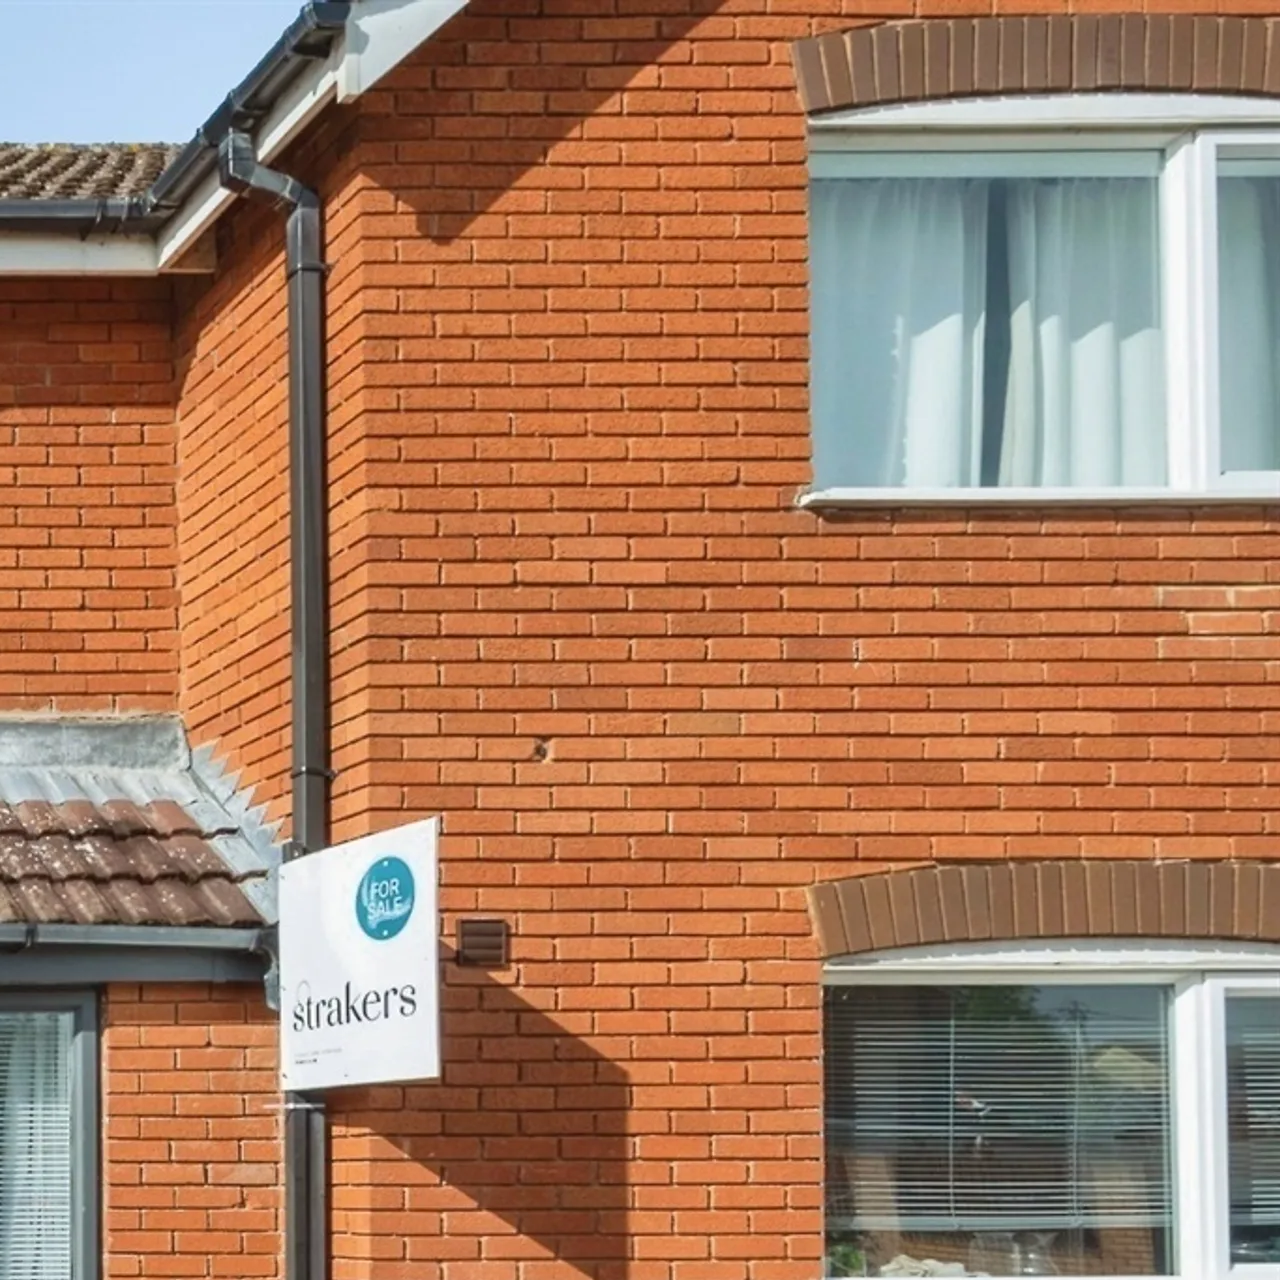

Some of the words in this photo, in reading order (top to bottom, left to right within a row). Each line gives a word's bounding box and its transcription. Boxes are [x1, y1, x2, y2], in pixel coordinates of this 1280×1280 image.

[370, 877, 400, 901] FOR
[367, 896, 404, 920] SALE
[292, 980, 417, 1032] strakers
